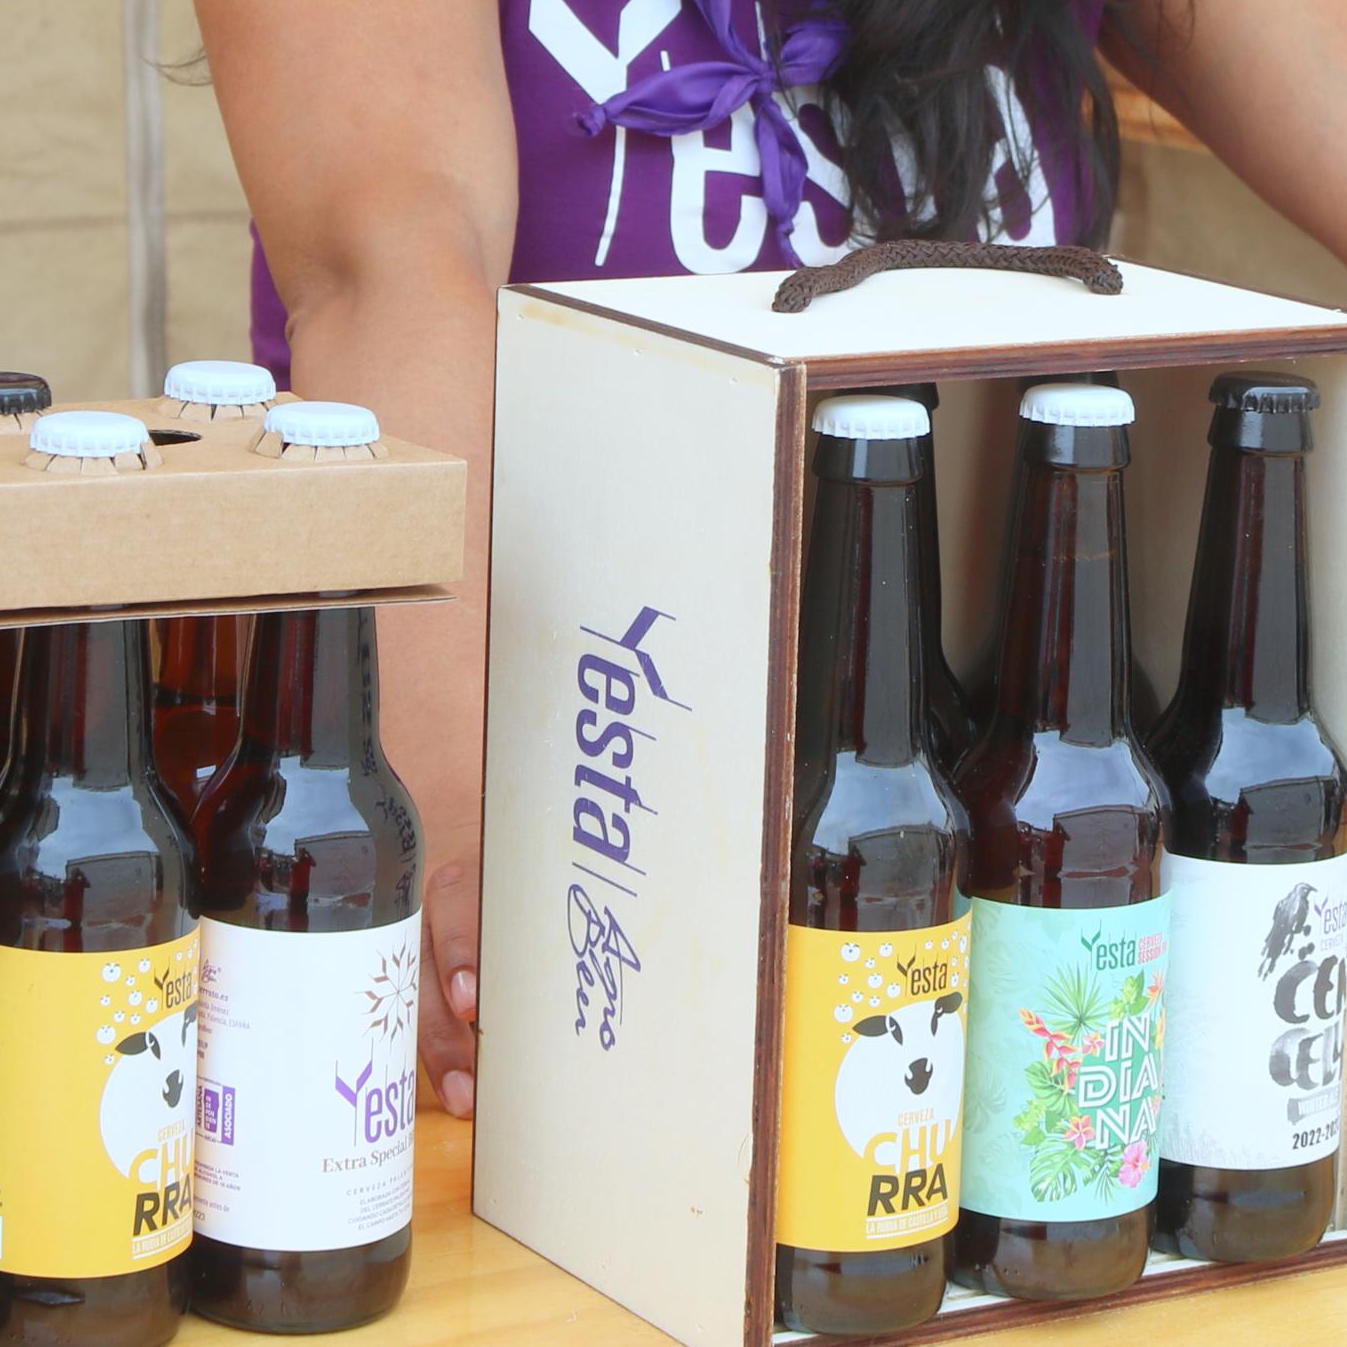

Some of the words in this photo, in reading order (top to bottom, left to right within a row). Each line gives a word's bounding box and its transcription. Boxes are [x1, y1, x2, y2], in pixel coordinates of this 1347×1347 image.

[572, 606, 694, 875] Yesta
[568, 884, 606, 1036] Beer
[896, 943, 948, 995] Yesta
[1081, 919, 1136, 971] Yesta
[154, 956, 192, 1009] Yesta
[592, 906, 641, 1050] Agro
[1104, 1013, 1152, 1063] IN
[335, 1038, 414, 1146] Yesta
[1078, 1060, 1157, 1109] DIA
[224, 1093, 233, 1140] ASOCIADO
[898, 1108, 934, 1127] CERVEZA
[1095, 1101, 1157, 1150] NA
[323, 1156, 367, 1173] Extra
[371, 1134, 408, 1167] Special
[133, 1173, 192, 1237] RRA
[346, 1180, 386, 1197] CERVEZA
[867, 1163, 948, 1216] RRA
